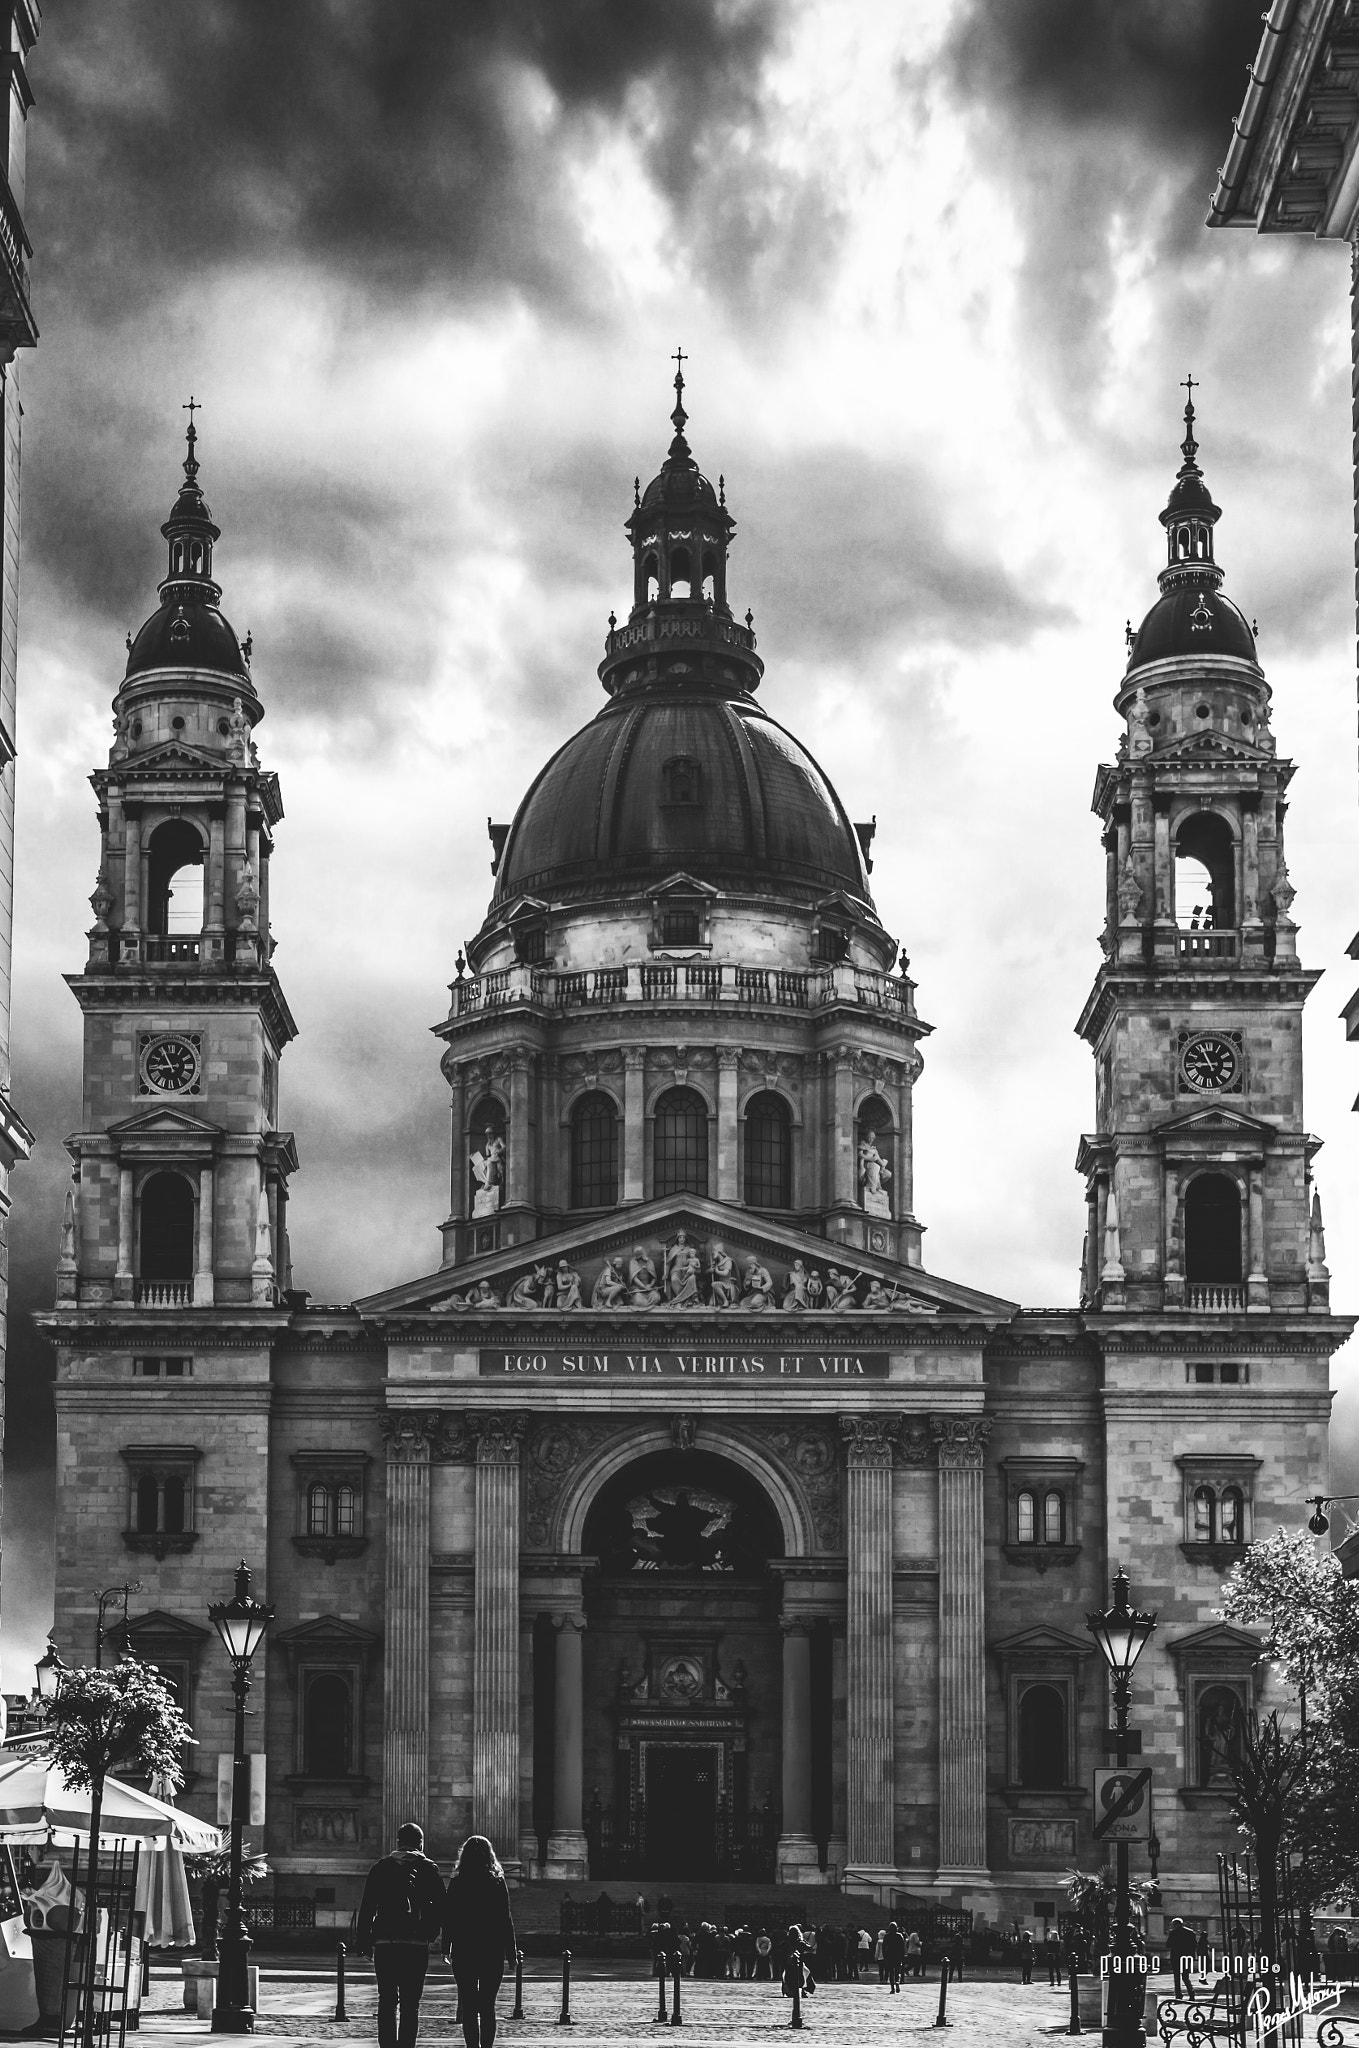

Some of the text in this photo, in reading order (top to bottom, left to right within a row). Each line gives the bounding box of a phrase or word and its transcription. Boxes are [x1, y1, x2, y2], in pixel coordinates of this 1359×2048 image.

[504, 1355, 865, 1374] EGO SUM VIA VERITAS ET VITA
[1108, 1824, 1138, 1832] ZONA
